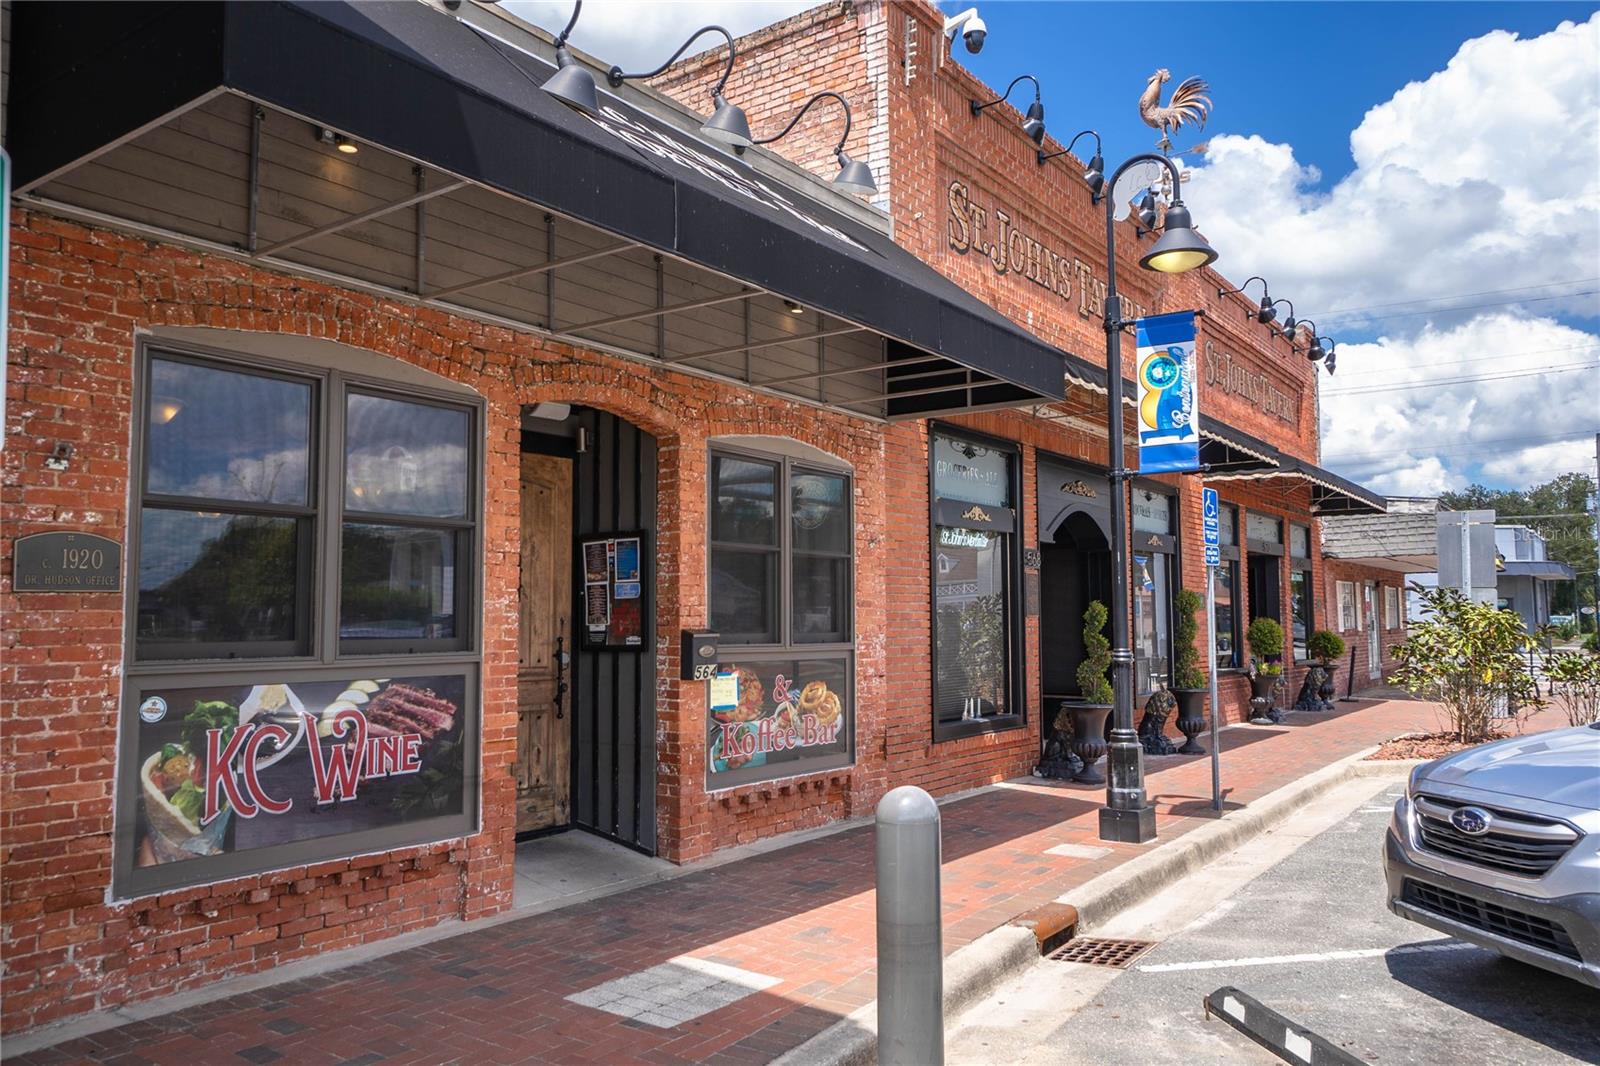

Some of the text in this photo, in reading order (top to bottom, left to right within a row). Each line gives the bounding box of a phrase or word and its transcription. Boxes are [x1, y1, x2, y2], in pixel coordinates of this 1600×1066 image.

[989, 208, 1072, 300] JOHNS
[1223, 353, 1259, 405] JOHNS
[1259, 375, 1296, 424] TAVERN
[62, 548, 104, 570] 1920
[44, 575, 81, 585] HUDSON
[86, 575, 116, 586] OFFICE
[695, 664, 718, 680] 564
[772, 674, 793, 703] &
[720, 713, 838, 760] Koffee Bar
[200, 721, 293, 826] KC
